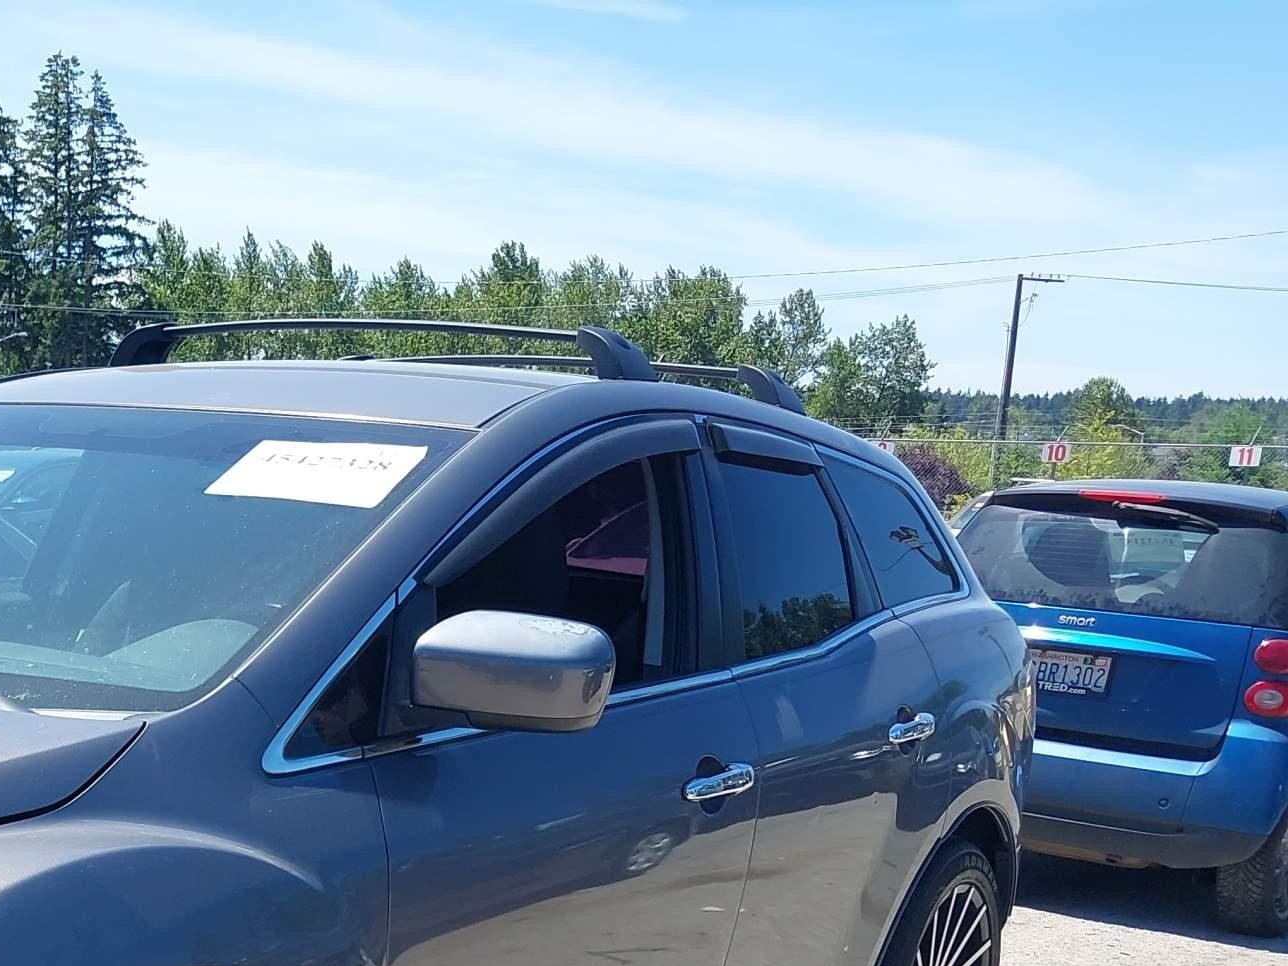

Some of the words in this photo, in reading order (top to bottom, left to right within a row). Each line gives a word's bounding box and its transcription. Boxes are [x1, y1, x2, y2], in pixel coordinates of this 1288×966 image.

[1047, 444, 1066, 461] 10
[1238, 447, 1254, 465] 11
[1058, 614, 1097, 627] smart
[1032, 660, 1106, 689] BR1302
[1037, 681, 1086, 695] TRED.com
